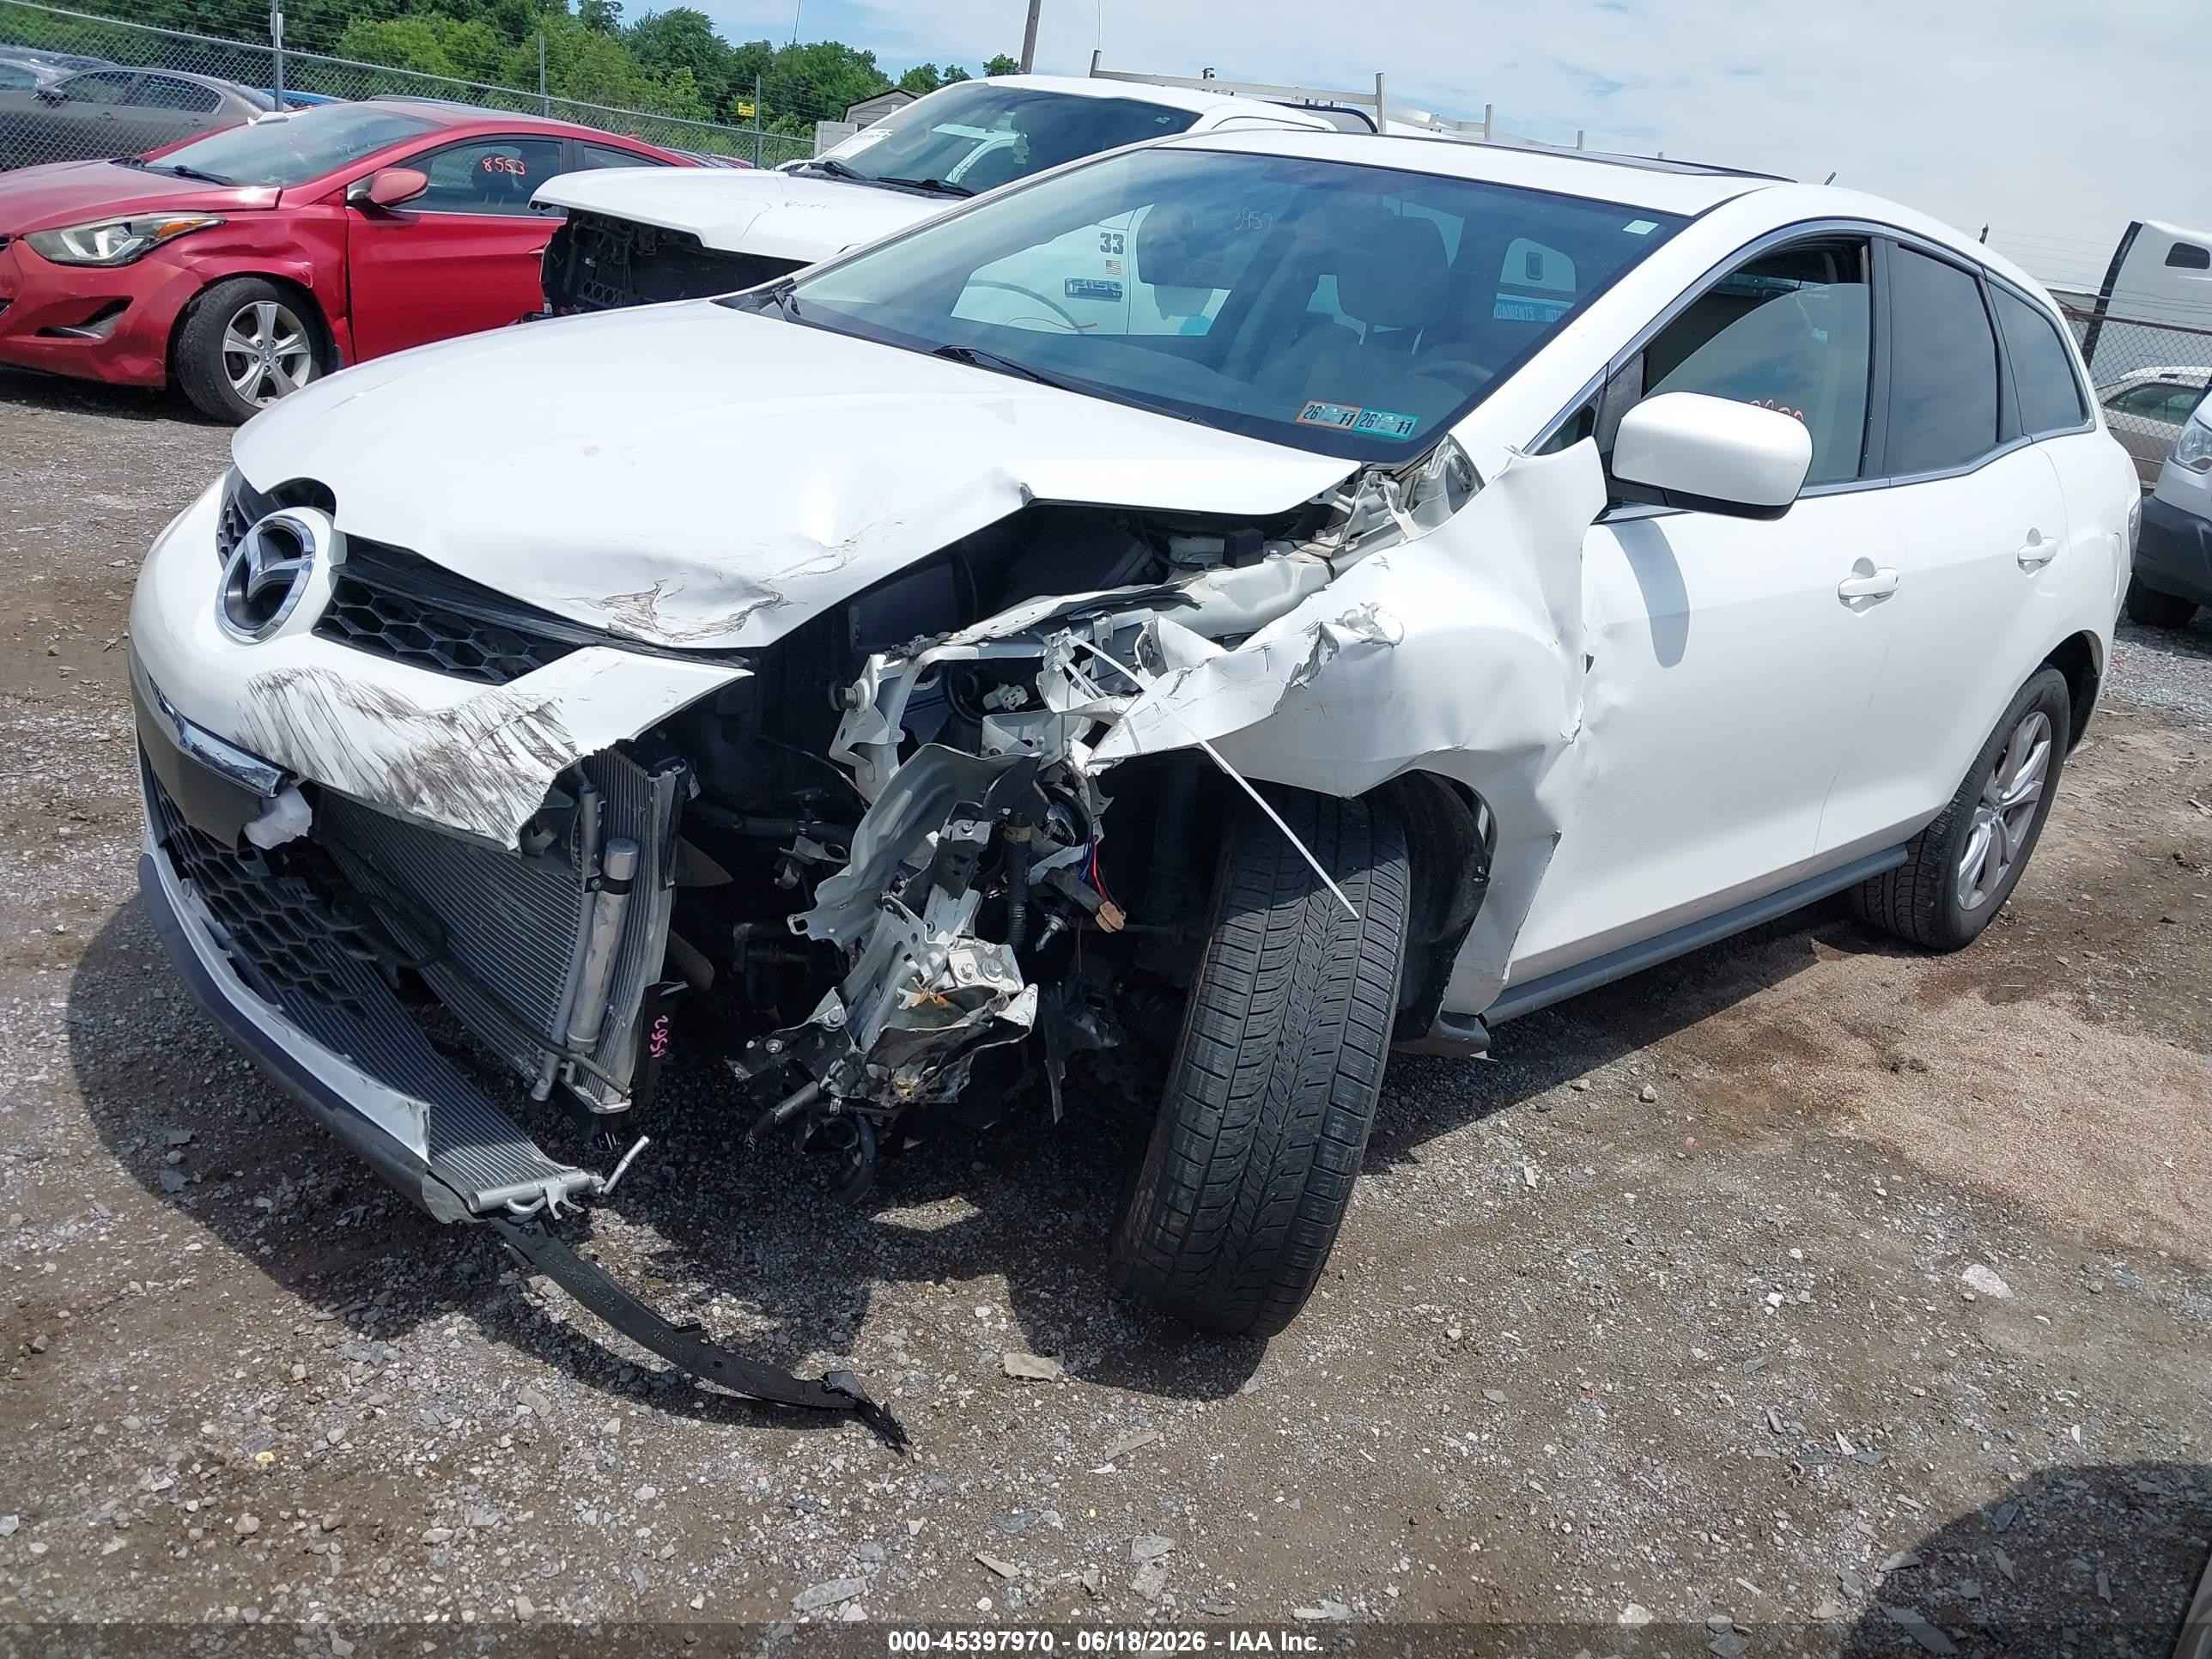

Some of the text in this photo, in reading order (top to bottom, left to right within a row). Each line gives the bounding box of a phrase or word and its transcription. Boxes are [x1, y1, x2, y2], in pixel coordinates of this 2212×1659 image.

[1100, 232, 1124, 255] 33
[1303, 404, 1322, 420] 26
[1358, 412, 1377, 428] 26
